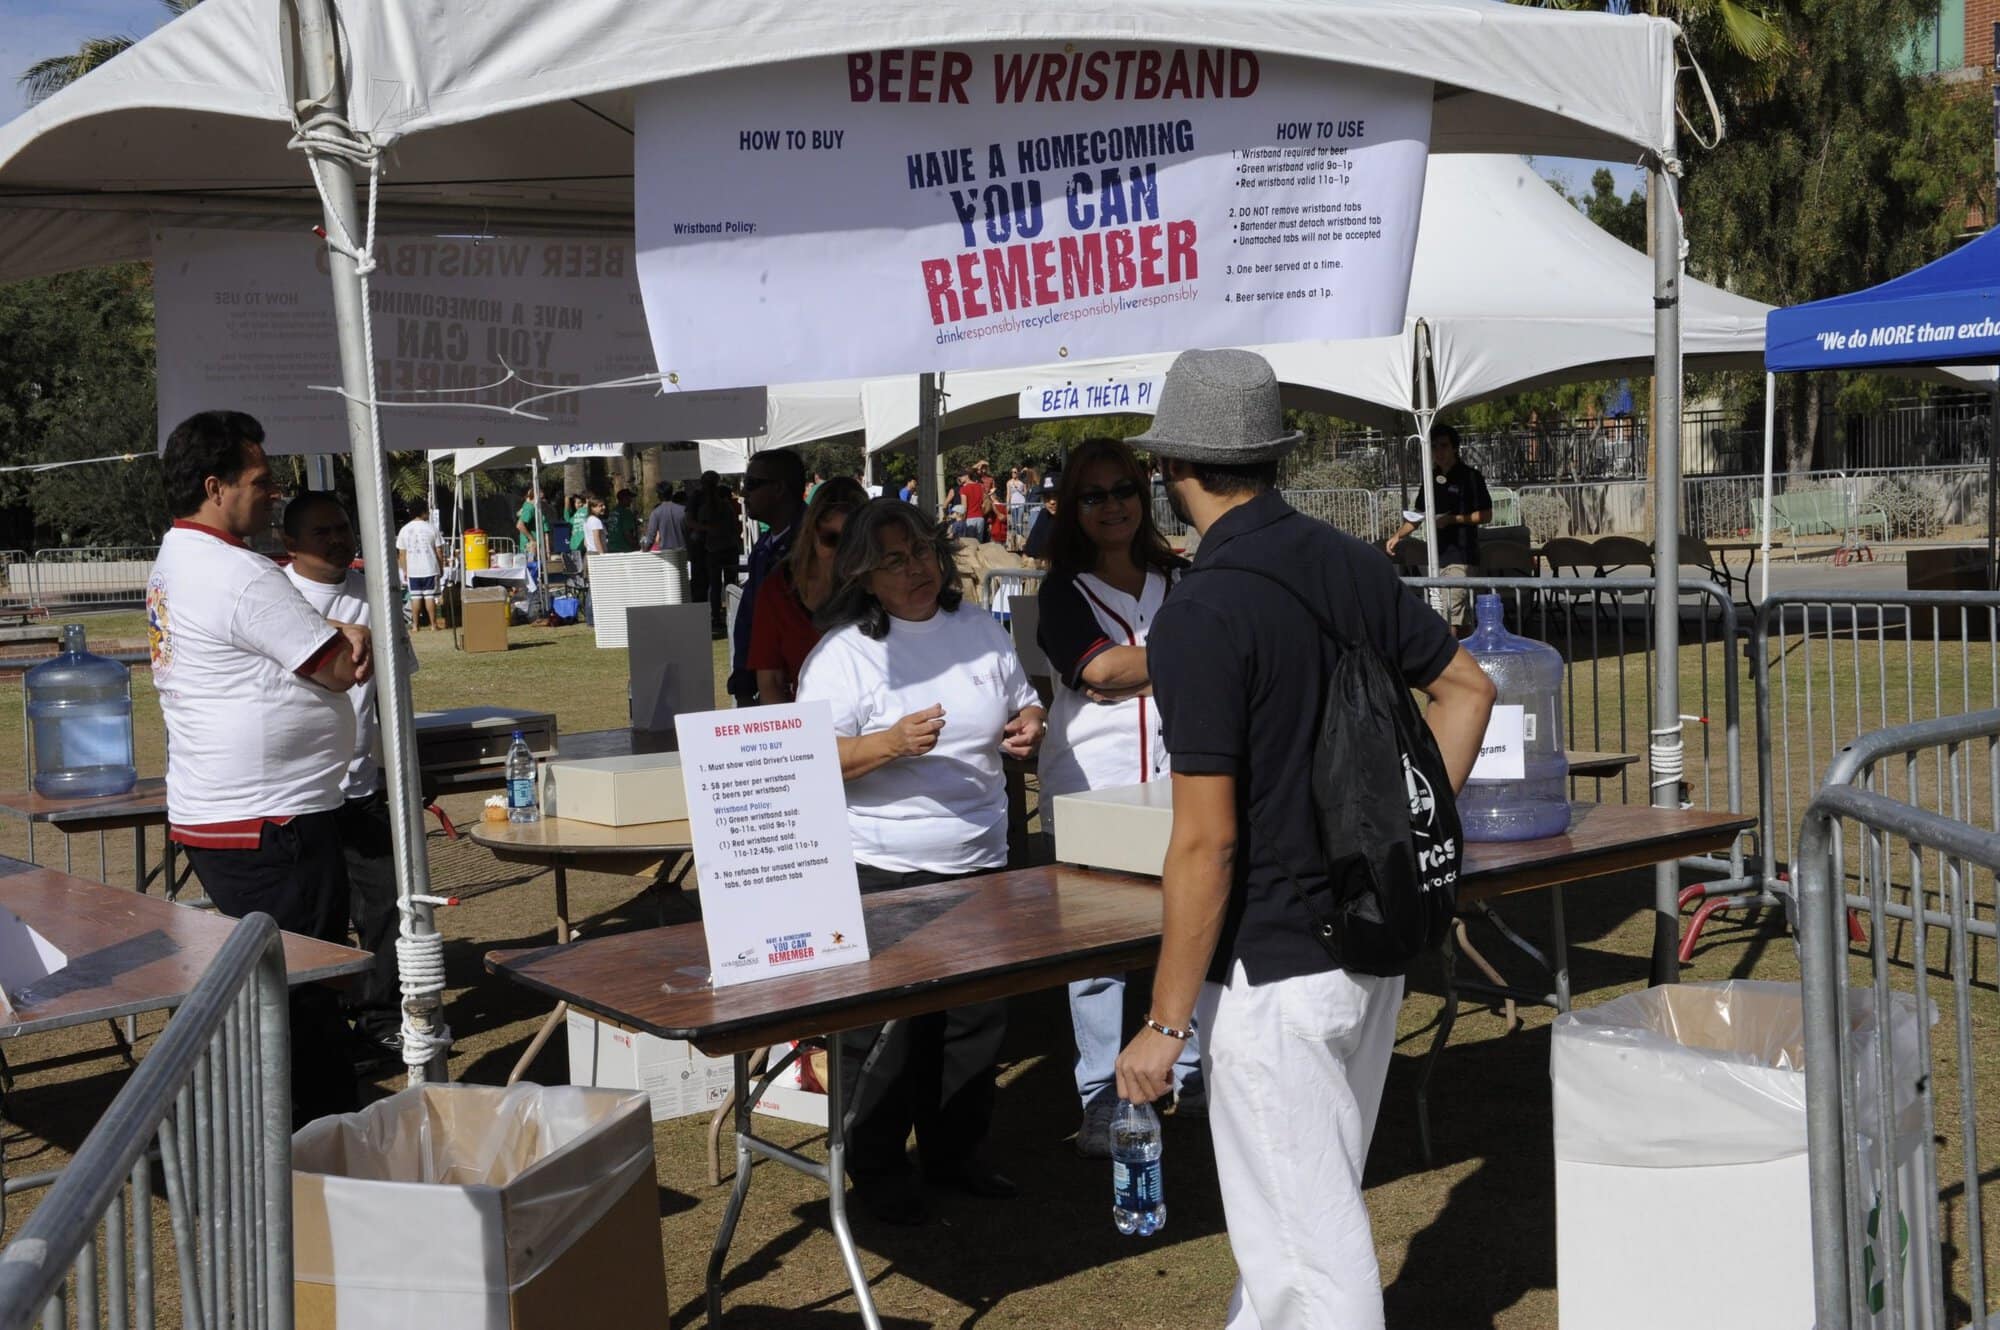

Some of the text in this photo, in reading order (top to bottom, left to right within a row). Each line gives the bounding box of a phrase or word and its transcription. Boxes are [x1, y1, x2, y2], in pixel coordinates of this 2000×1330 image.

[847, 48, 1260, 105] BEER WRISTBAND
[1277, 120, 1365, 140] HOW TO USE
[740, 130, 844, 150] HOW TO BUY
[907, 119, 1194, 189] HAVE A HOMECOMING
[1232, 147, 1348, 159] 1. Wristband required for beer
[1242, 164, 1264, 173] Green
[1267, 162, 1303, 172] wristband
[1306, 161, 1324, 170] valid
[1241, 179, 1255, 188] Red
[1258, 176, 1294, 187] wristband
[1298, 175, 1315, 185] valid
[949, 163, 1160, 247] YOU CAN
[1229, 203, 1362, 217] 2. DO NOT remove wristband tabs
[673, 222, 757, 235] Wristband Policy:
[1240, 216, 1382, 231] Bartender must detach wristband tab
[1239, 230, 1381, 246] Unattached tabs will not be accepted
[921, 219, 1199, 326] REMEMBER
[1226, 260, 1343, 275] 3. One beer served at a time.
[1225, 288, 1333, 303] 4. Beer service ends at 1p.
[1848, 330, 1867, 348] do
[1870, 325, 1915, 346] MORE
[1917, 322, 1955, 342] than
[1042, 382, 1152, 412] BETA THETA PI
[715, 718, 802, 737] BEER WRISTBAND
[741, 745, 756, 753] HOW
[769, 742, 783, 750] BUY
[708, 763, 724, 772] Must
[726, 761, 744, 770] show
[746, 758, 761, 768] valid
[764, 756, 788, 765] Driver's
[790, 753, 814, 762] License
[722, 781, 733, 789] per
[735, 779, 750, 787] beer
[752, 778, 762, 786] per
[765, 773, 796, 783] wristband
[722, 790, 741, 799] beers
[755, 785, 791, 795] wristband)
[714, 802, 772, 815] Wristband Policy:
[729, 815, 748, 824] Green
[750, 811, 782, 821] wristband
[784, 809, 800, 817] sold:
[759, 822, 774, 832] valid
[732, 839, 745, 847] Red
[747, 835, 779, 845] wristband
[777, 843, 793, 852] valid
[723, 870, 733, 879] No
[735, 867, 760, 876] refunds
[772, 862, 795, 871] unused
[798, 857, 828, 866] wristband
[725, 880, 741, 889] tabs,
[753, 877, 764, 885] not
[766, 874, 787, 883] detach
[788, 872, 803, 880] tabs
[773, 939, 807, 952] YOU CAN
[768, 947, 814, 964] REMEMBER
